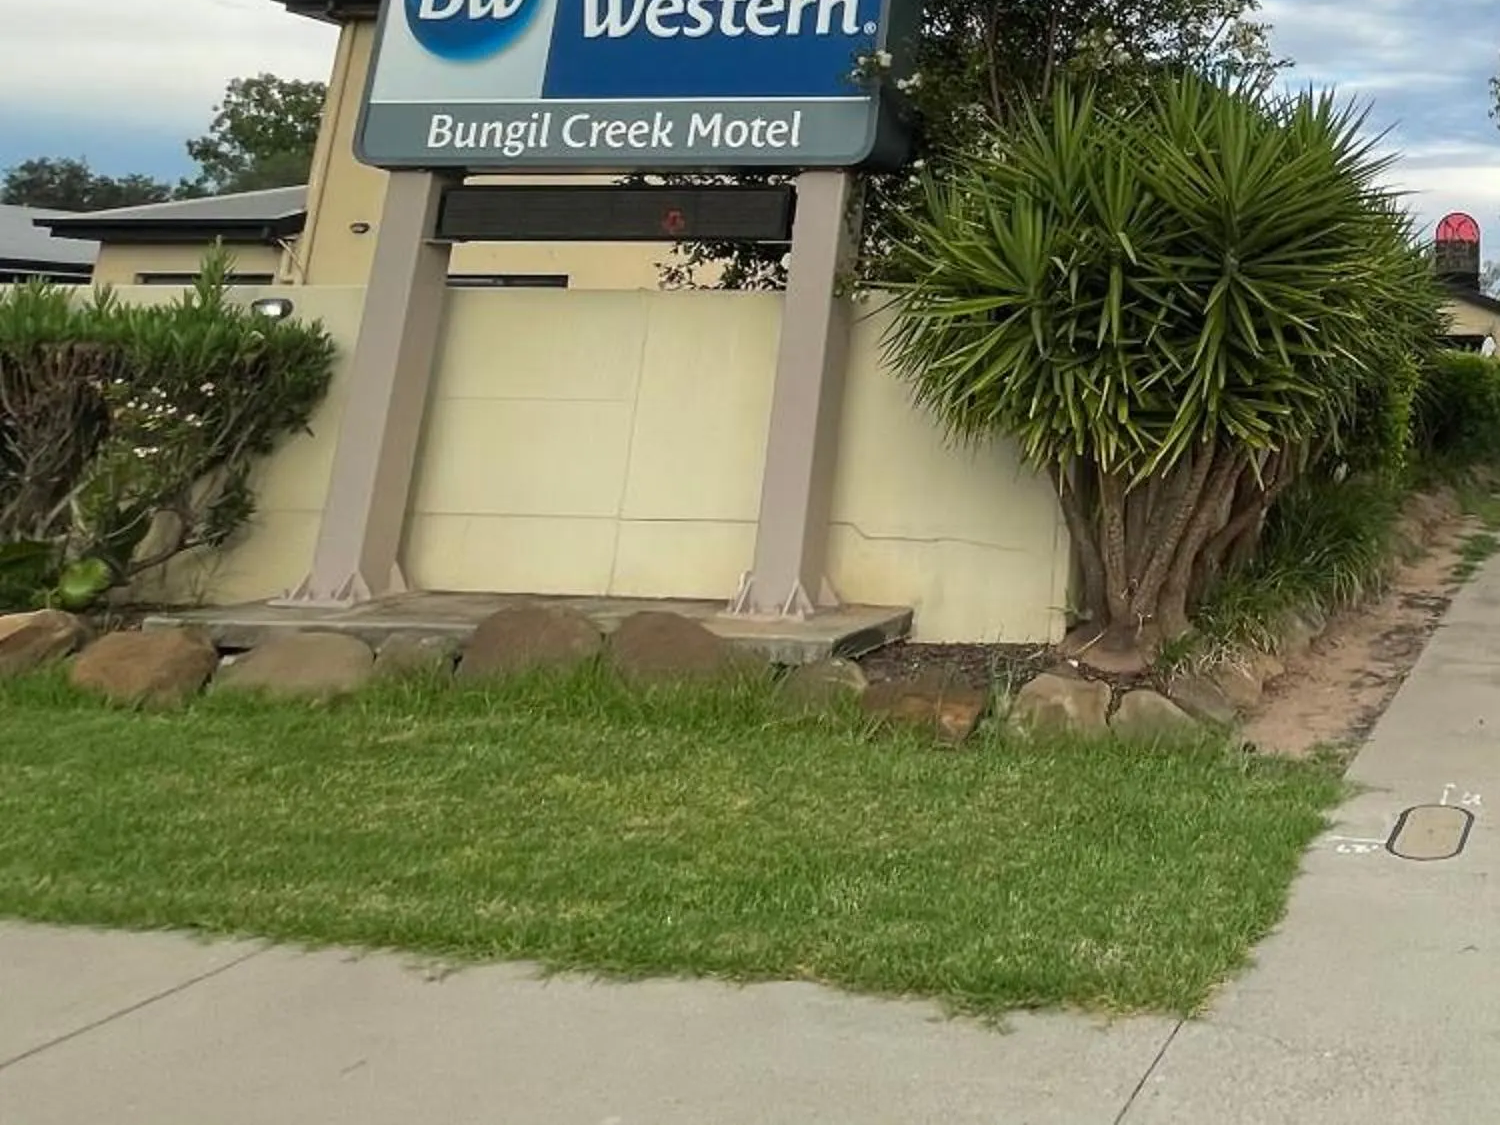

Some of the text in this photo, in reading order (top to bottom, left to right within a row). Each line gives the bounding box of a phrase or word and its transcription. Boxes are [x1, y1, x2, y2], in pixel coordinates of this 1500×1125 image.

[426, 110, 801, 158] Bungil Creek Motel
